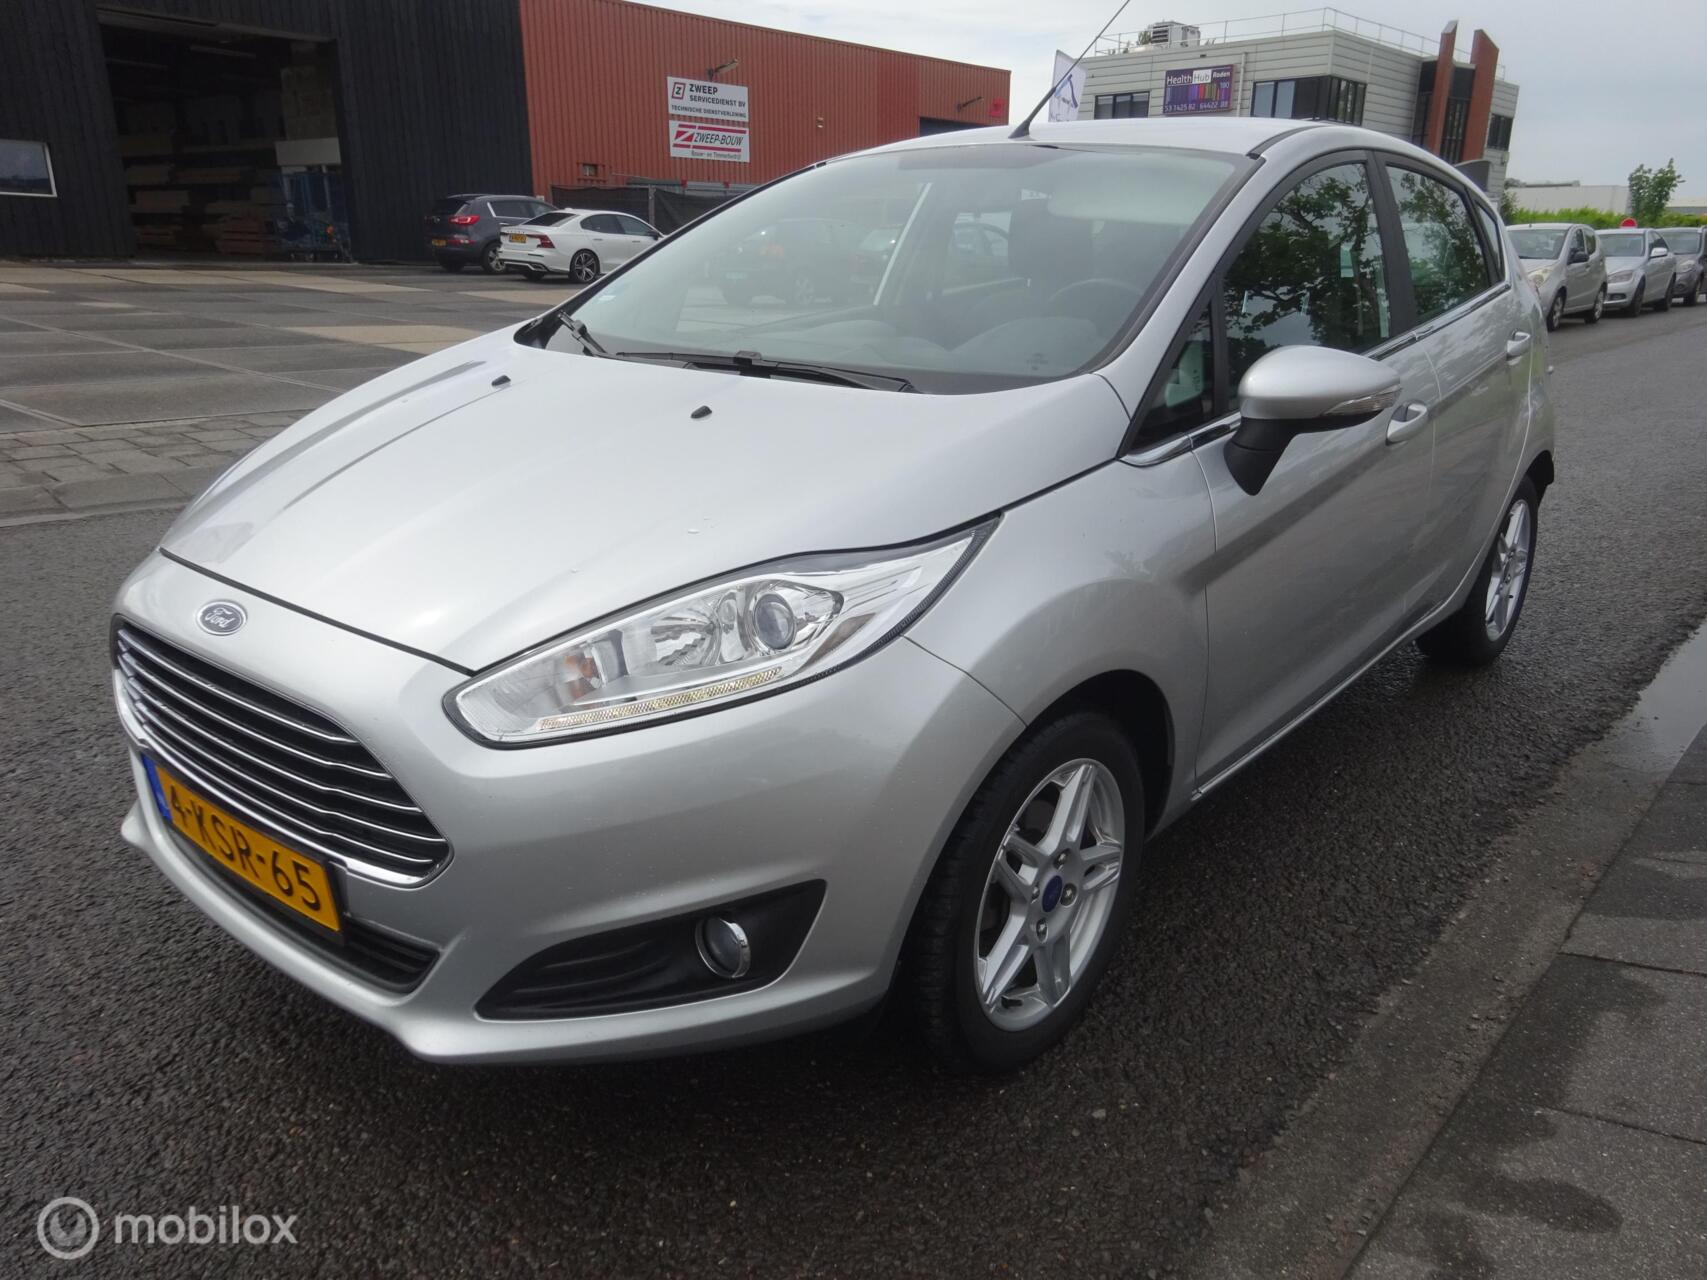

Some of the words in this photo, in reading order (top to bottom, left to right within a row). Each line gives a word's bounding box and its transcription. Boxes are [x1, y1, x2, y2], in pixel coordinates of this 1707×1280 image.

[1167, 74, 1192, 85] Health
[1194, 74, 1210, 83] Hub
[689, 84, 718, 95] ZWEEP
[689, 95, 737, 106] SERVICEDIENST
[738, 100, 746, 108] BV
[671, 105, 702, 113] TECHNISCHE
[703, 109, 746, 118] DIENSTVERLENING
[694, 132, 743, 146] ZWEEP-BOUW
[205, 607, 236, 628] Ford
